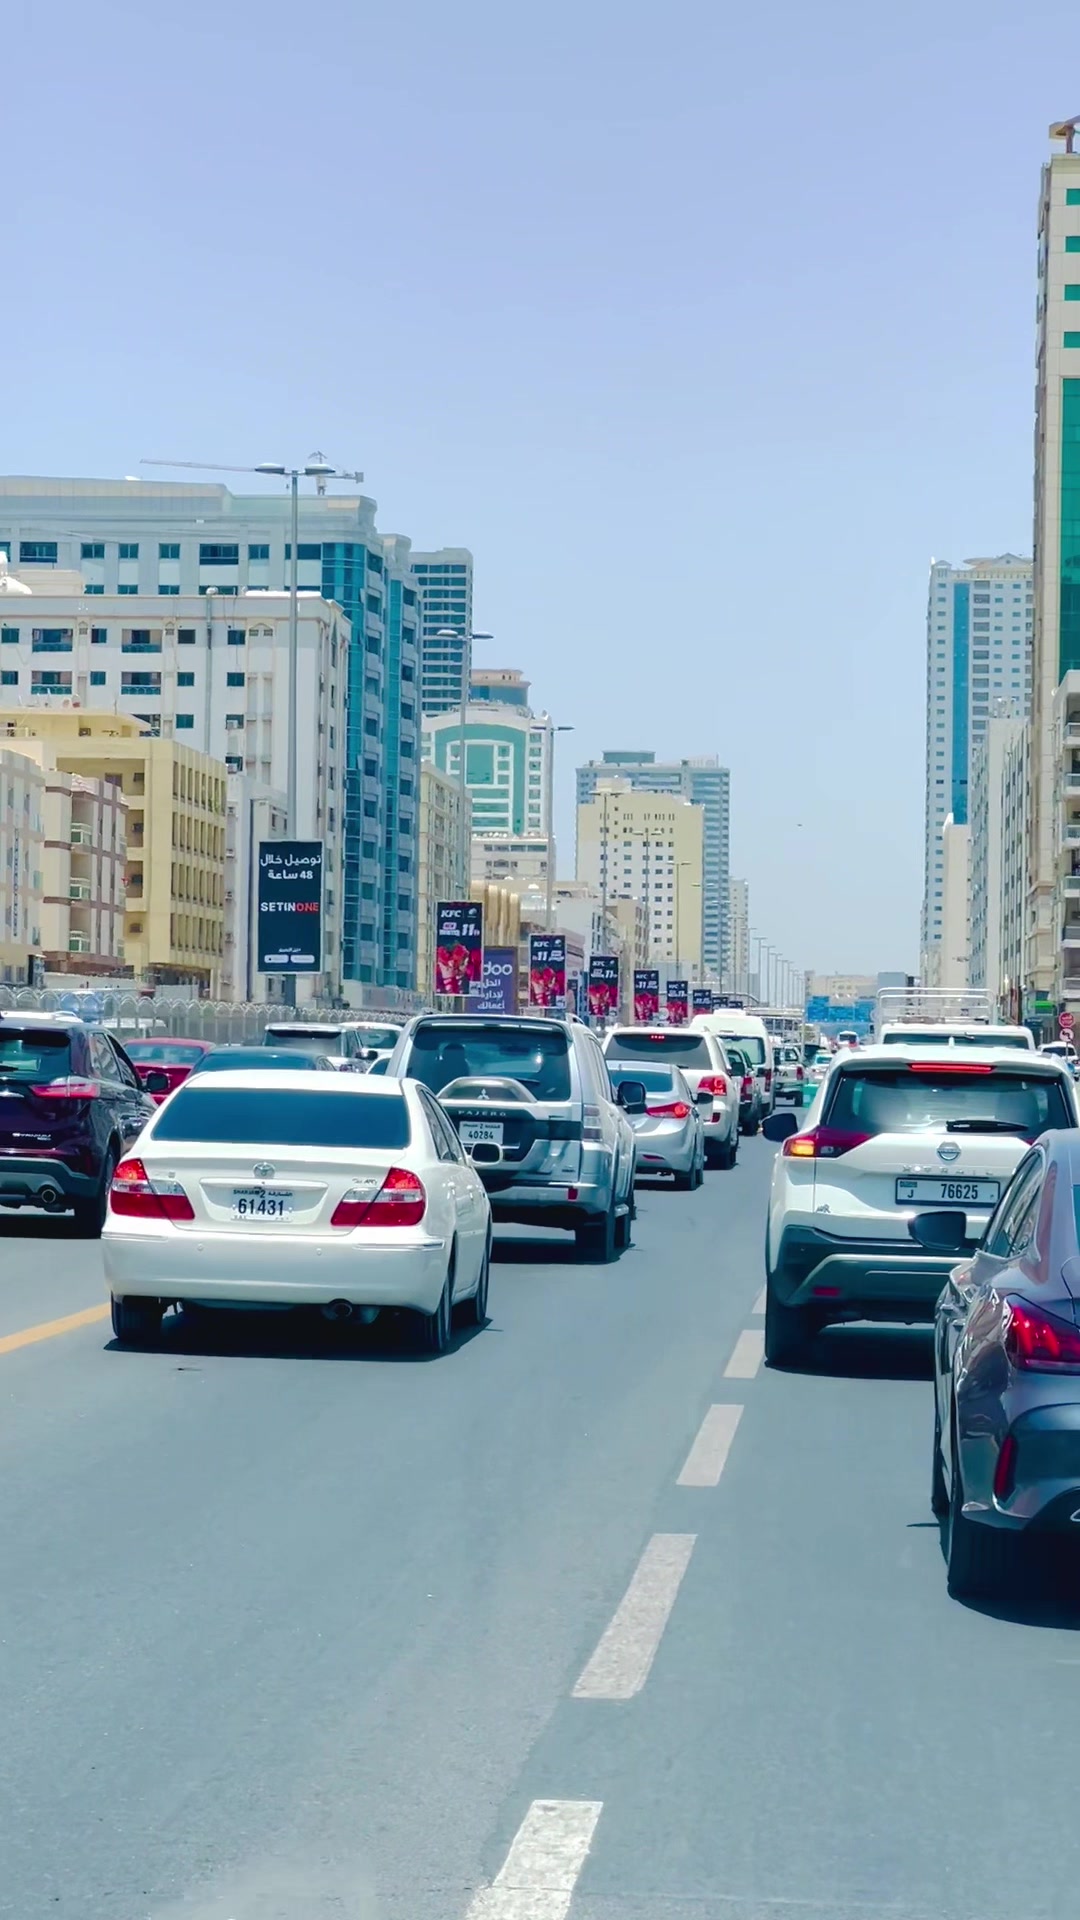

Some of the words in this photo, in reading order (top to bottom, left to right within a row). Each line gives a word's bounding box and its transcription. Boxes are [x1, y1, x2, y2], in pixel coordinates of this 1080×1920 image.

[260, 853, 283, 867] خلال
[285, 853, 321, 866] توصيل
[268, 869, 298, 879] ساعة
[300, 871, 313, 879] 48
[260, 902, 319, 911] SETINONE
[483, 961, 513, 975] doo
[468, 1131, 494, 1139] 40284
[906, 1189, 915, 1199] J
[940, 1183, 979, 1200] 76625
[238, 1199, 284, 1216] 61431
